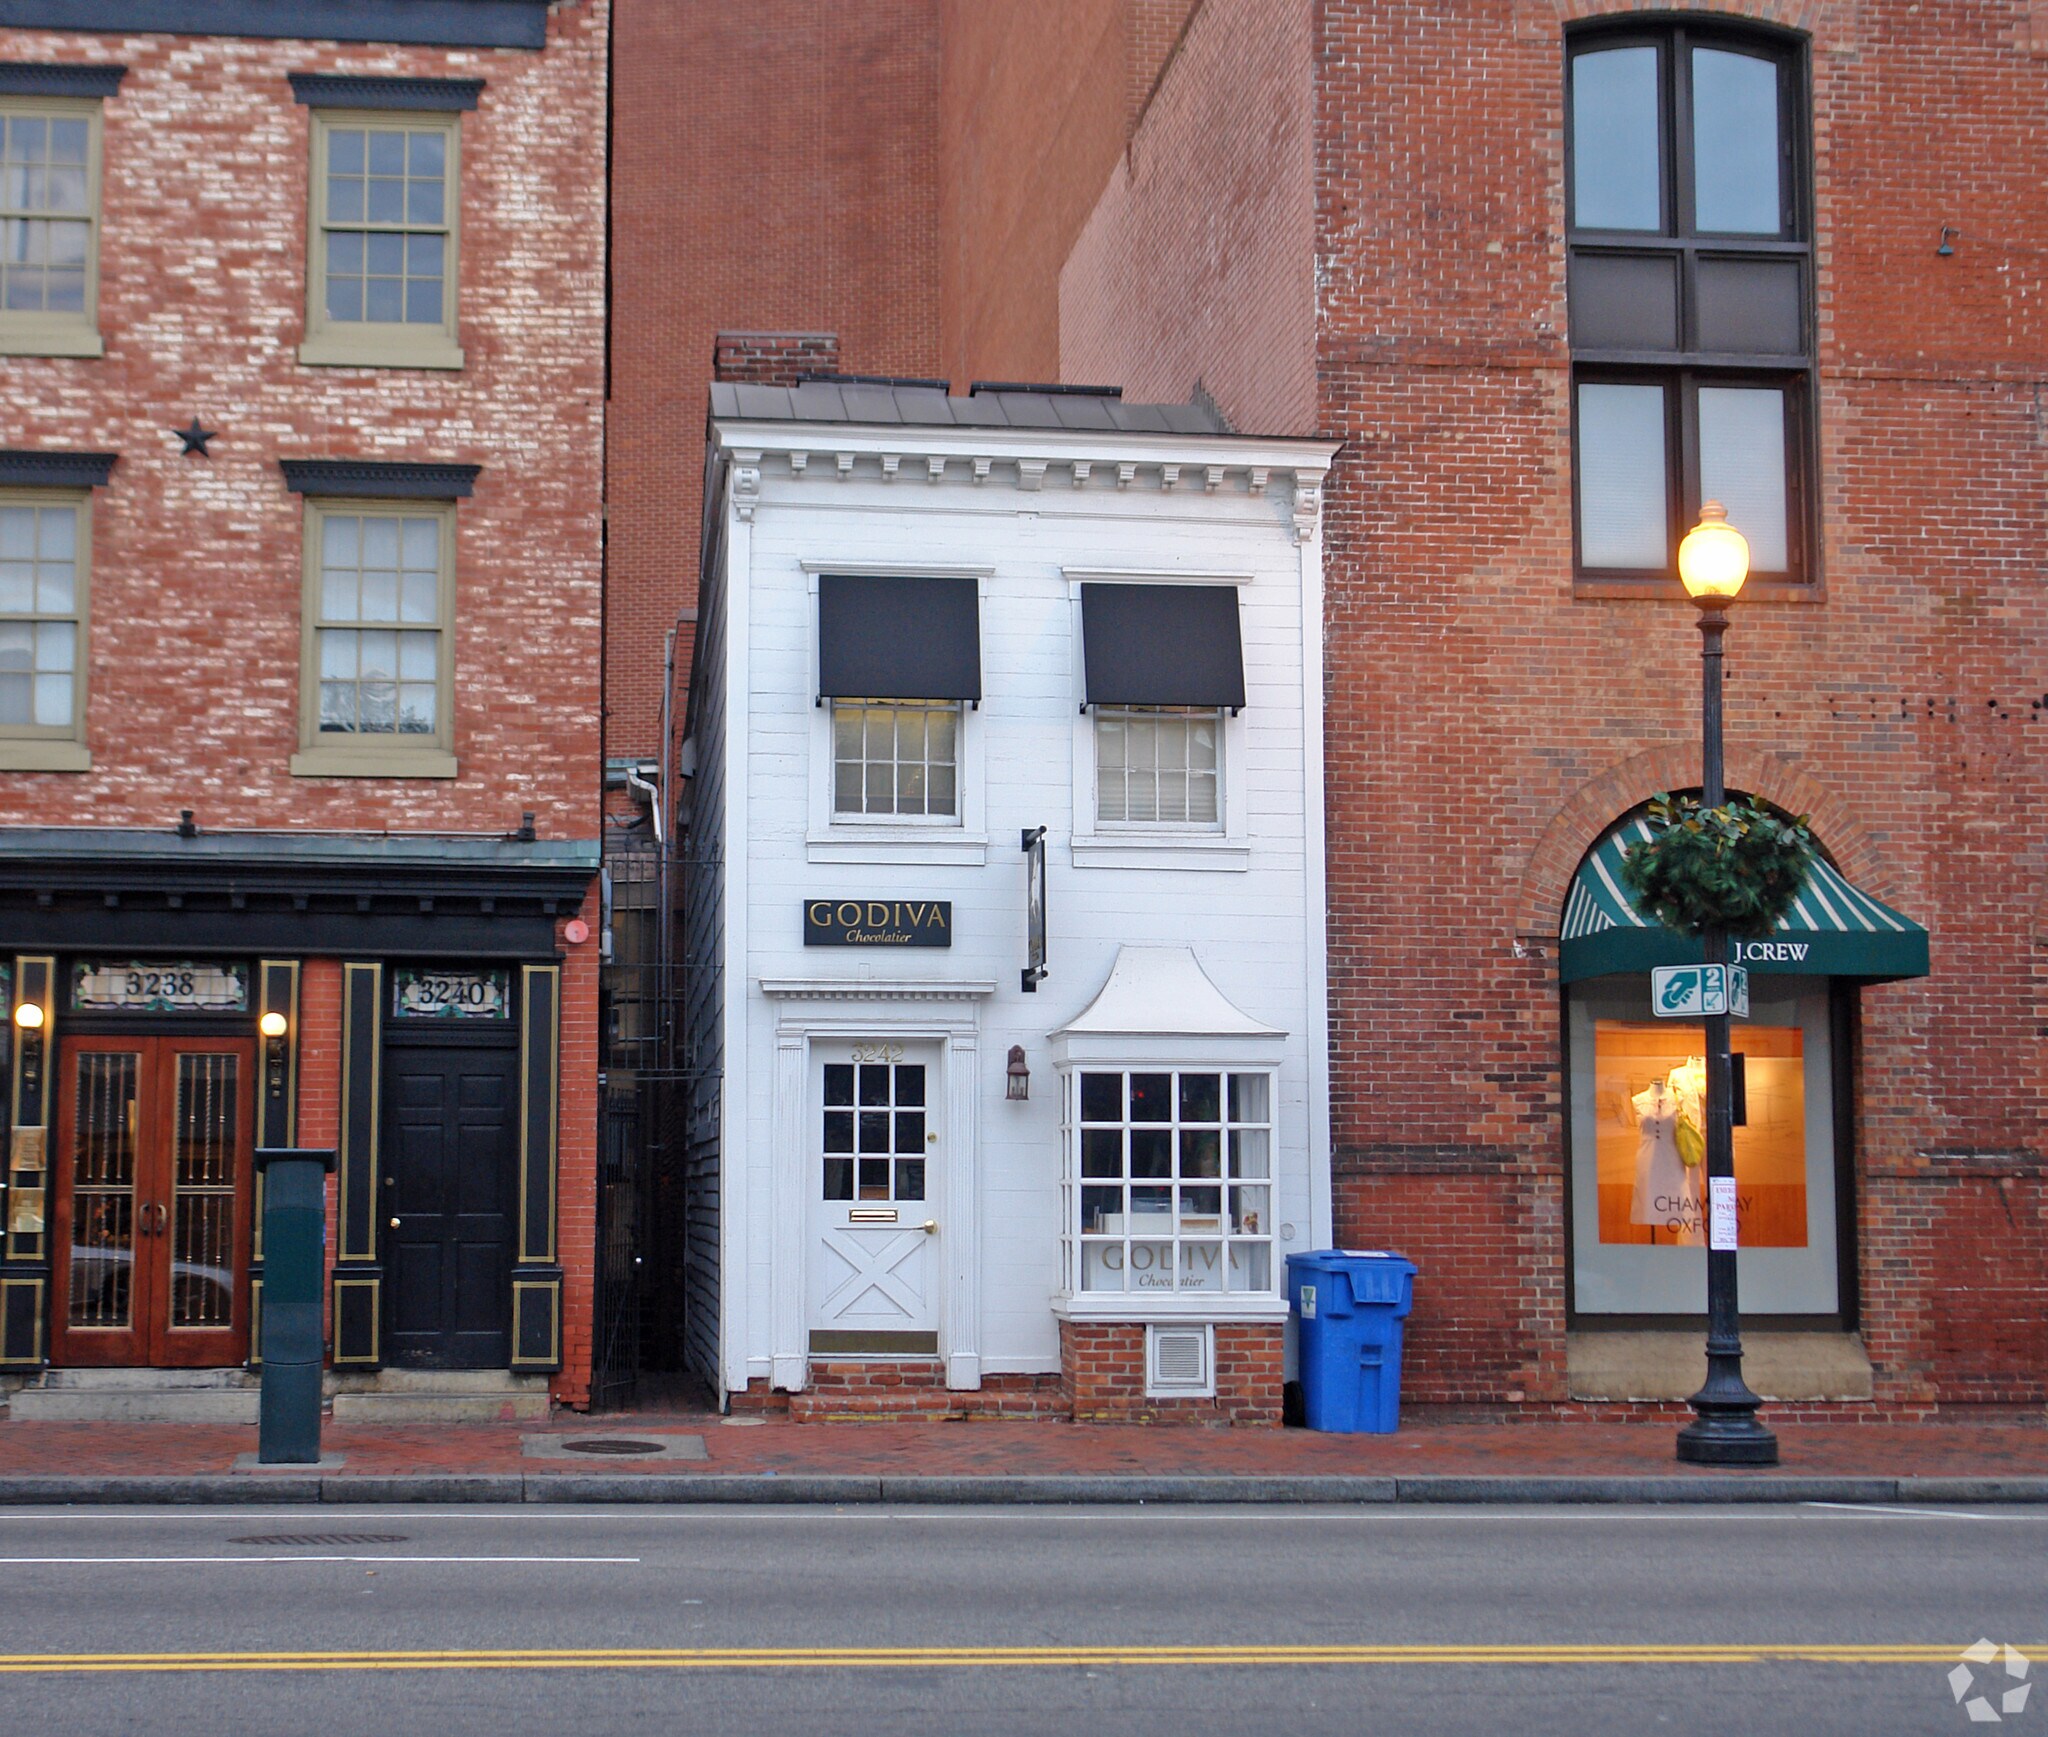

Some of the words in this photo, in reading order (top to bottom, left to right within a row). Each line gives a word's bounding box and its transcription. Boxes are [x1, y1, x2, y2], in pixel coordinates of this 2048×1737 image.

[808, 902, 946, 928] GODIVA
[845, 929, 912, 943] Chocolatier
[1733, 942, 1809, 964] J.CREW
[126, 972, 194, 996] 3238
[1706, 968, 1720, 987] 2
[420, 981, 485, 1005] 3240
[851, 1041, 904, 1062] 3242
[1654, 1196, 1753, 1212] CHAMAY
[1138, 1274, 1205, 1287] Chocoatier
